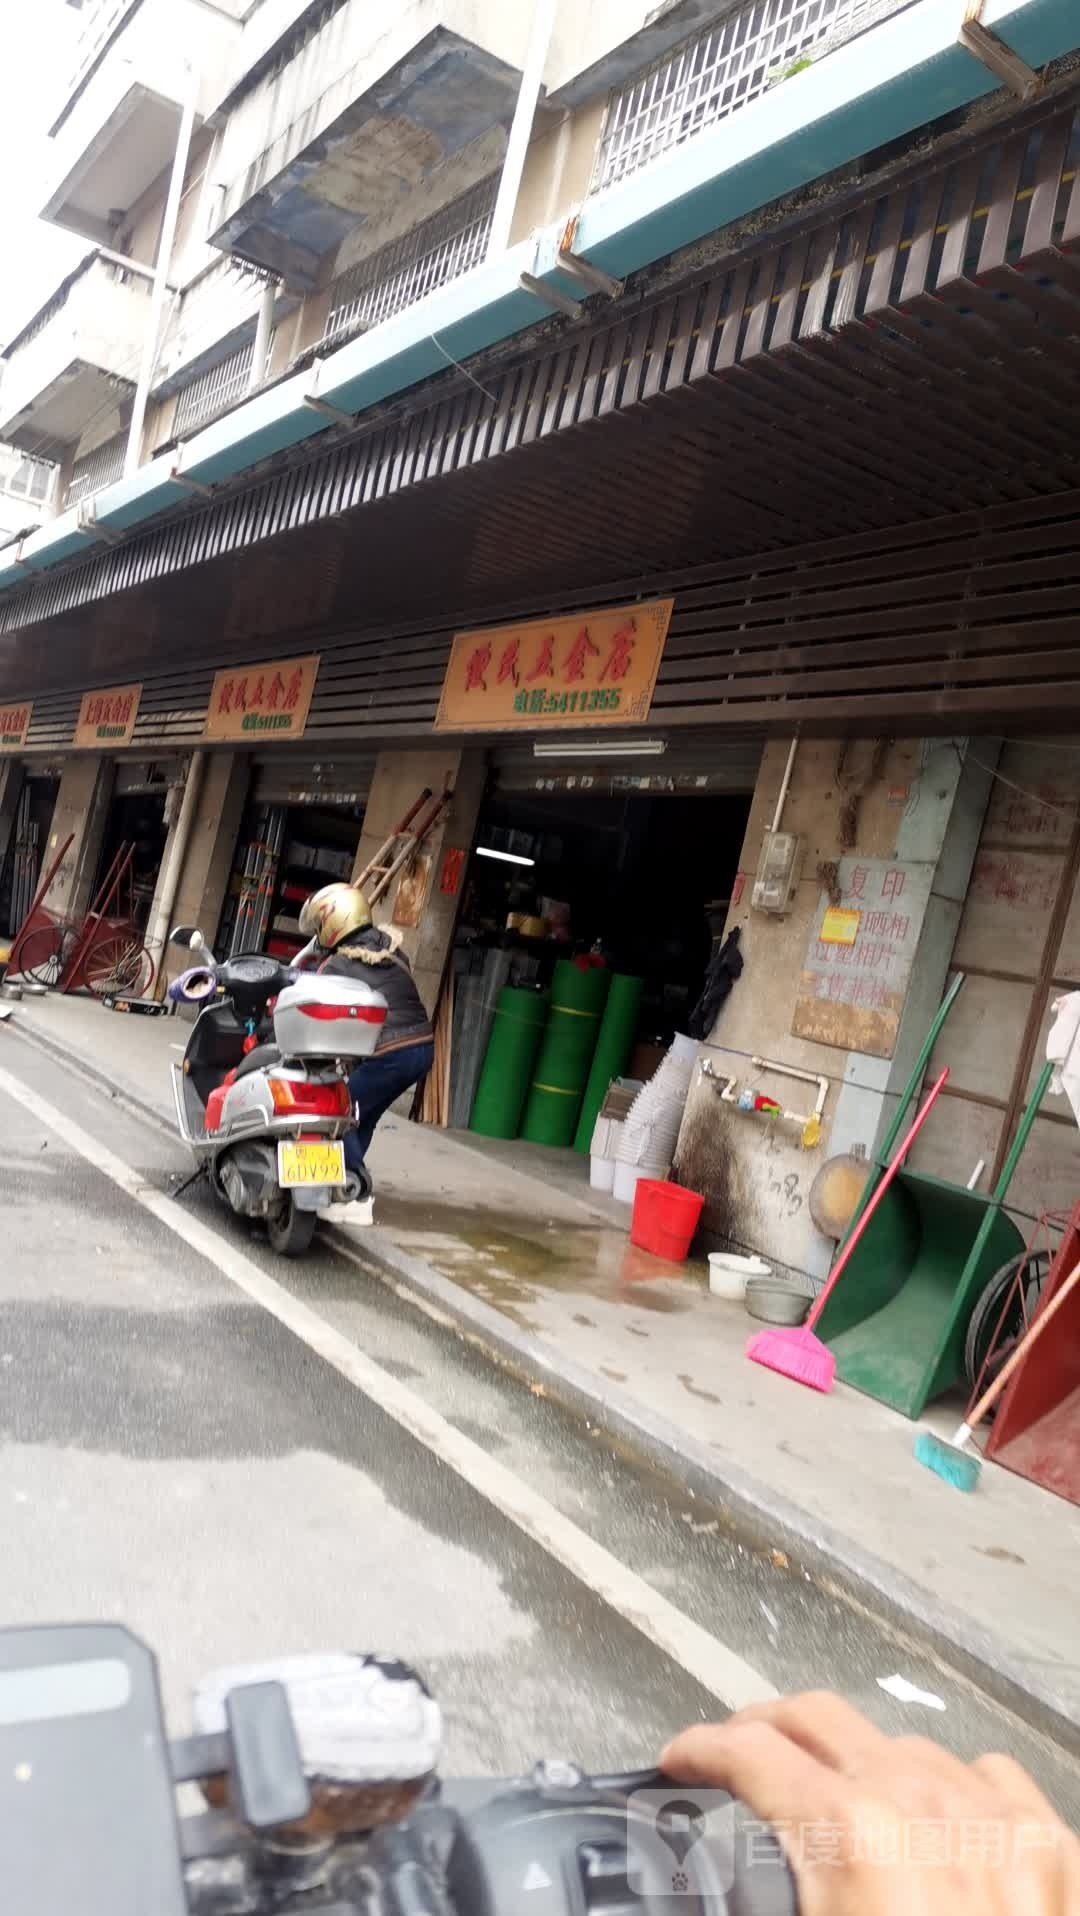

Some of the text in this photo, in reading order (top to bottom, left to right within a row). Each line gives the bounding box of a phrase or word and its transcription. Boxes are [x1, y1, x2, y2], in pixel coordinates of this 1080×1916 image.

[464, 617, 637, 692] 便民五金店
[848, 864, 906, 904] 复印
[287, 1160, 340, 1182] 6DV99
